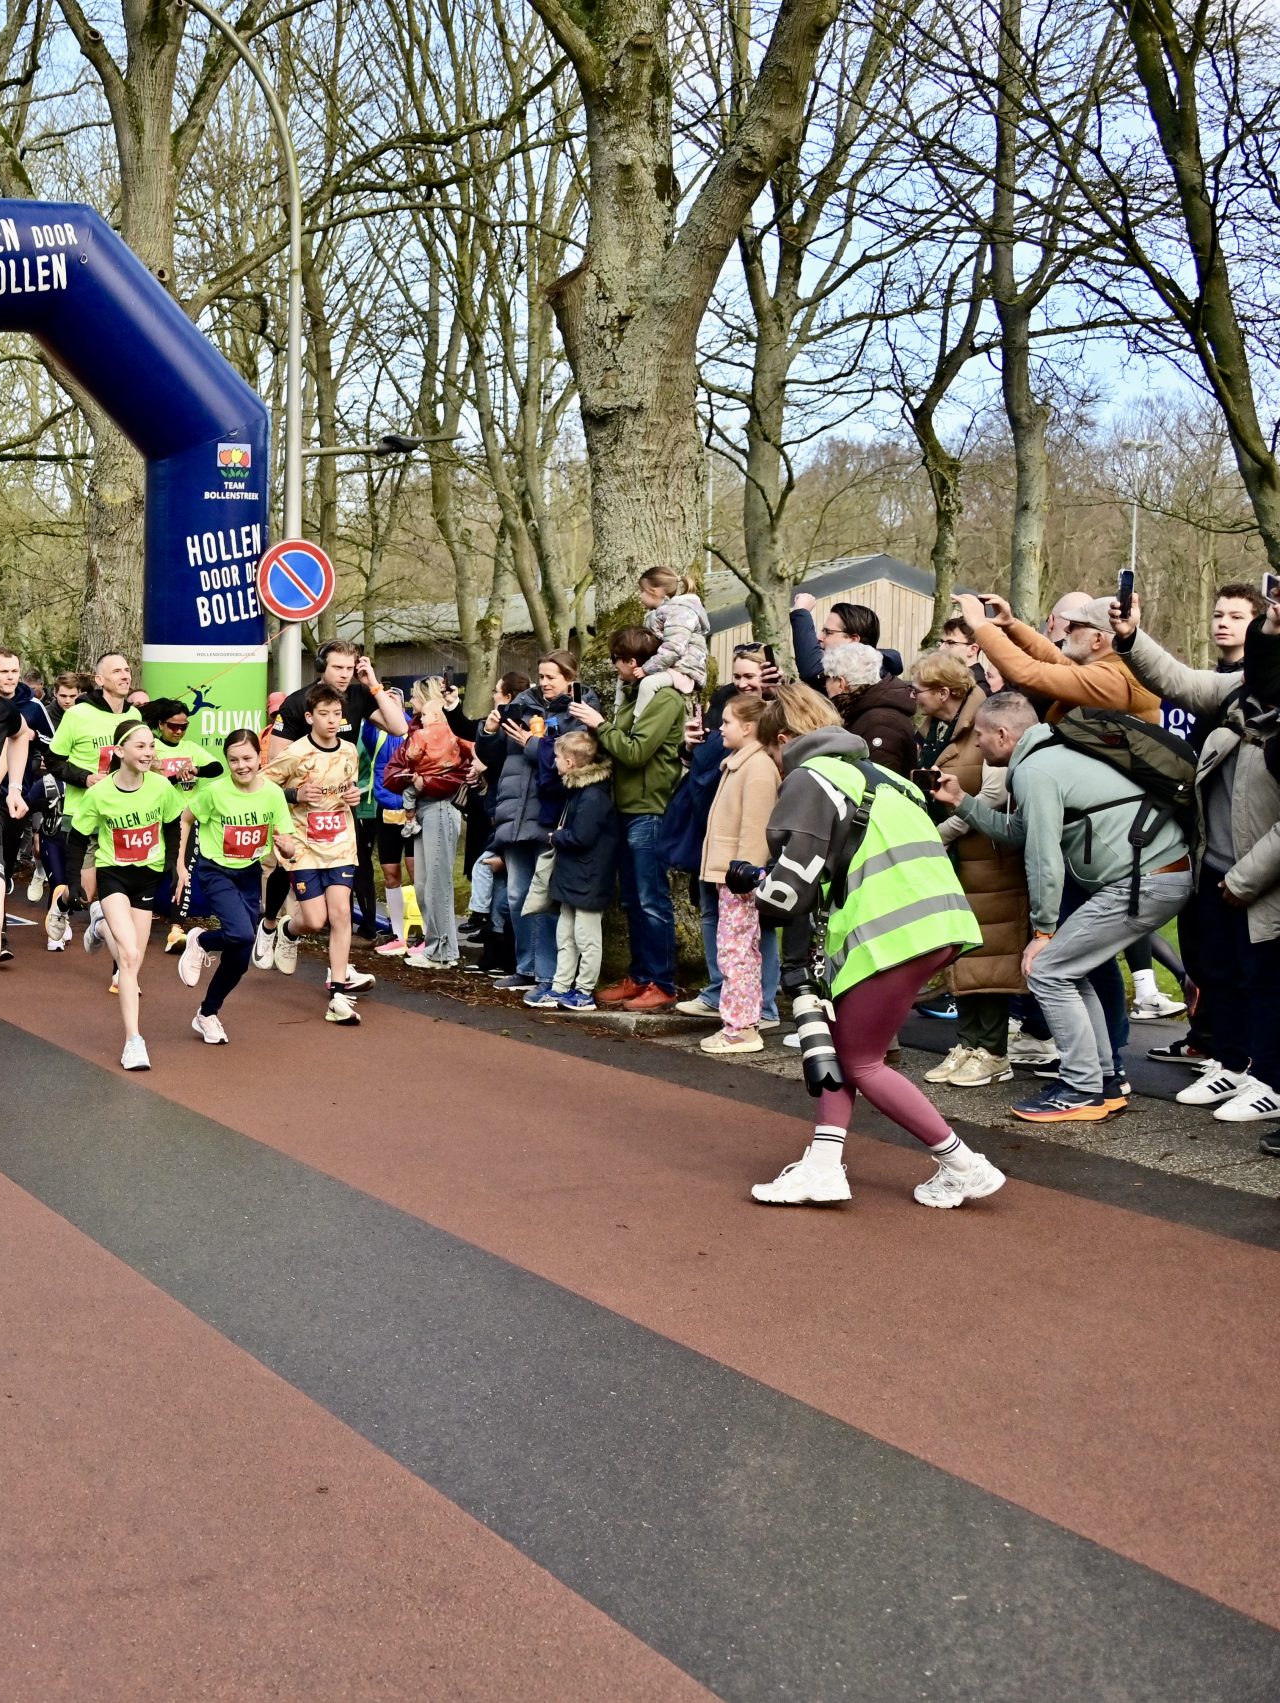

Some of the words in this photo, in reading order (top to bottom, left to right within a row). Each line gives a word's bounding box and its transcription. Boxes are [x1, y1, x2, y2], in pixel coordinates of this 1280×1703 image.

[31, 223, 78, 248] DOOR
[224, 482, 245, 490] TEAM
[204, 491, 259, 500] BOLLENSTREEK
[186, 523, 261, 567] HOLLEN
[200, 565, 240, 591] DOOR
[245, 561, 257, 584] DE
[201, 710, 263, 736] DUVAK
[315, 815, 341, 830] 333
[122, 830, 153, 848] 146
[234, 829, 262, 846] 168
